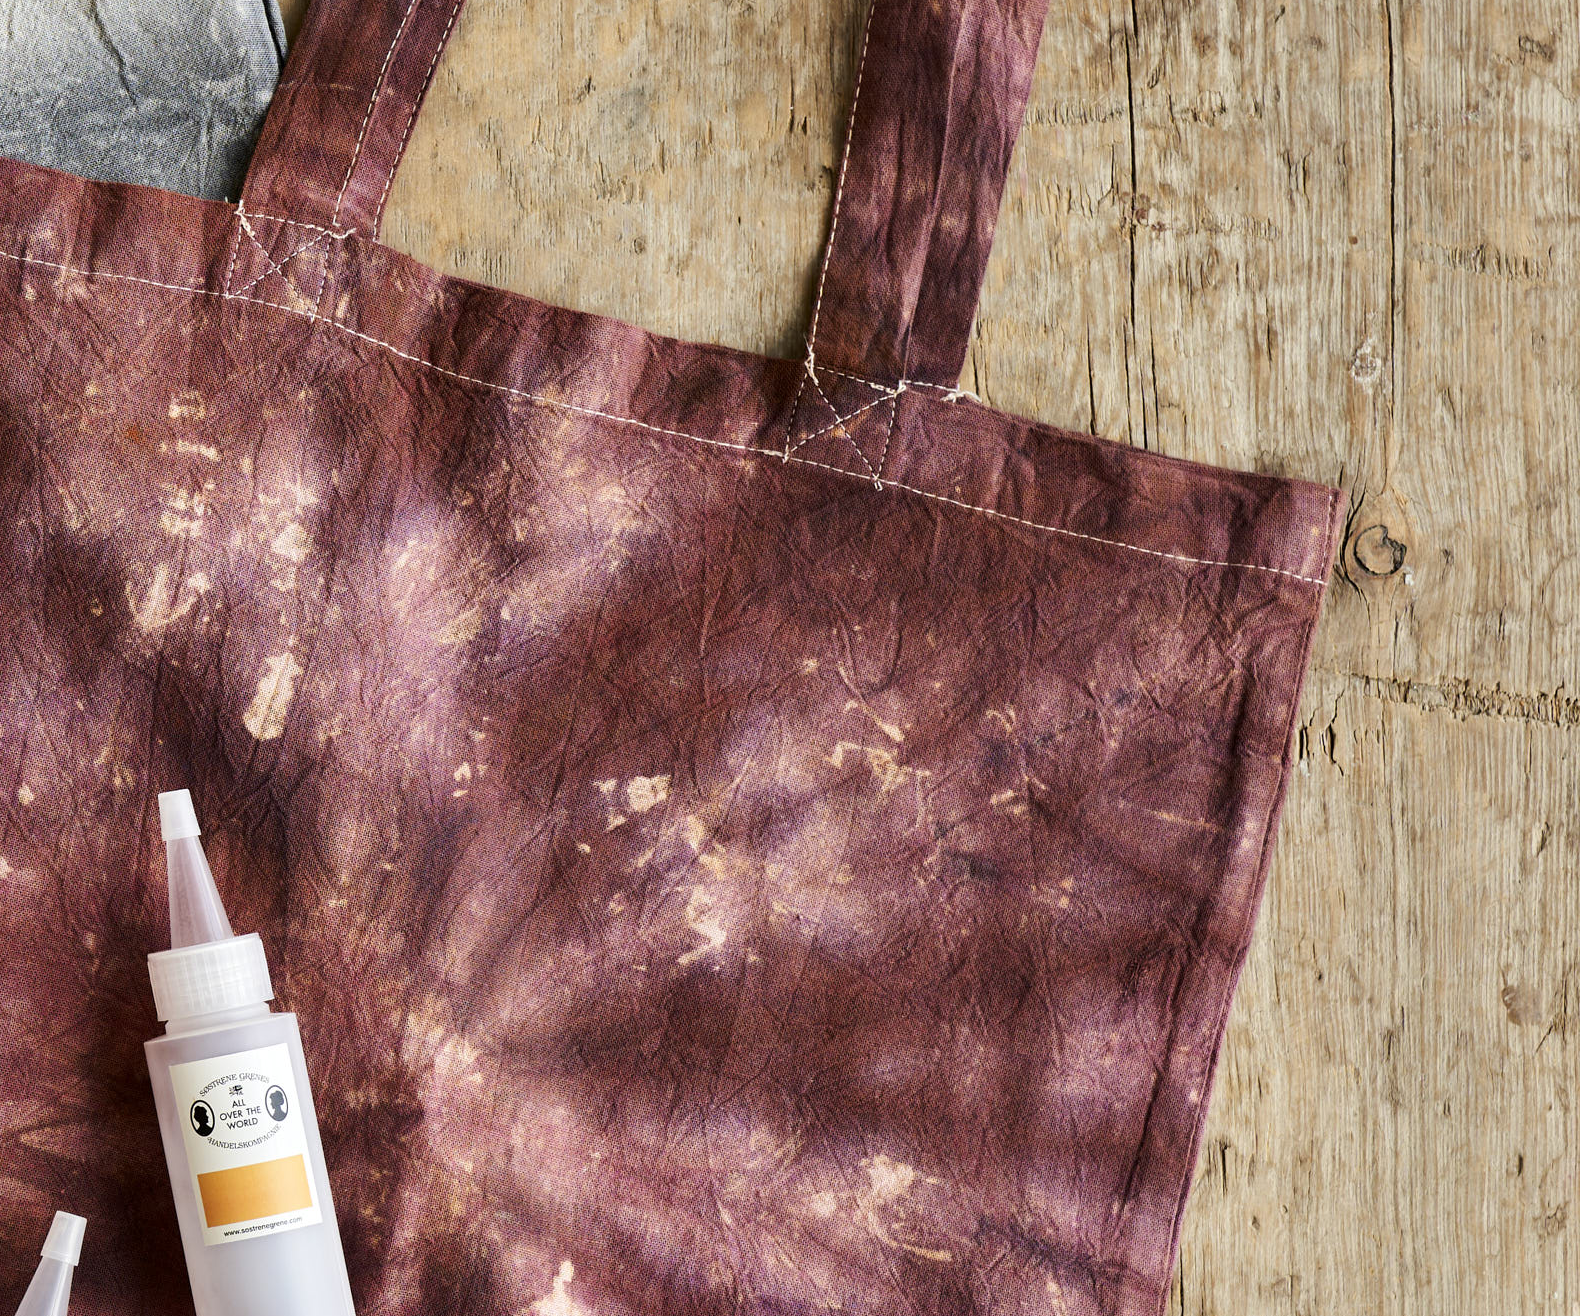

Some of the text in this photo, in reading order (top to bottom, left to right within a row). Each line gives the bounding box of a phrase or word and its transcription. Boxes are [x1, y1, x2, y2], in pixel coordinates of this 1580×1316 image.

[199, 1074, 238, 1097] SØSTRENE
[232, 1100, 246, 1108] ALL
[219, 1106, 262, 1121] OVER THE
[227, 1117, 258, 1130] WORLD
[223, 1216, 302, 1237] www.sostrenegrene.com
